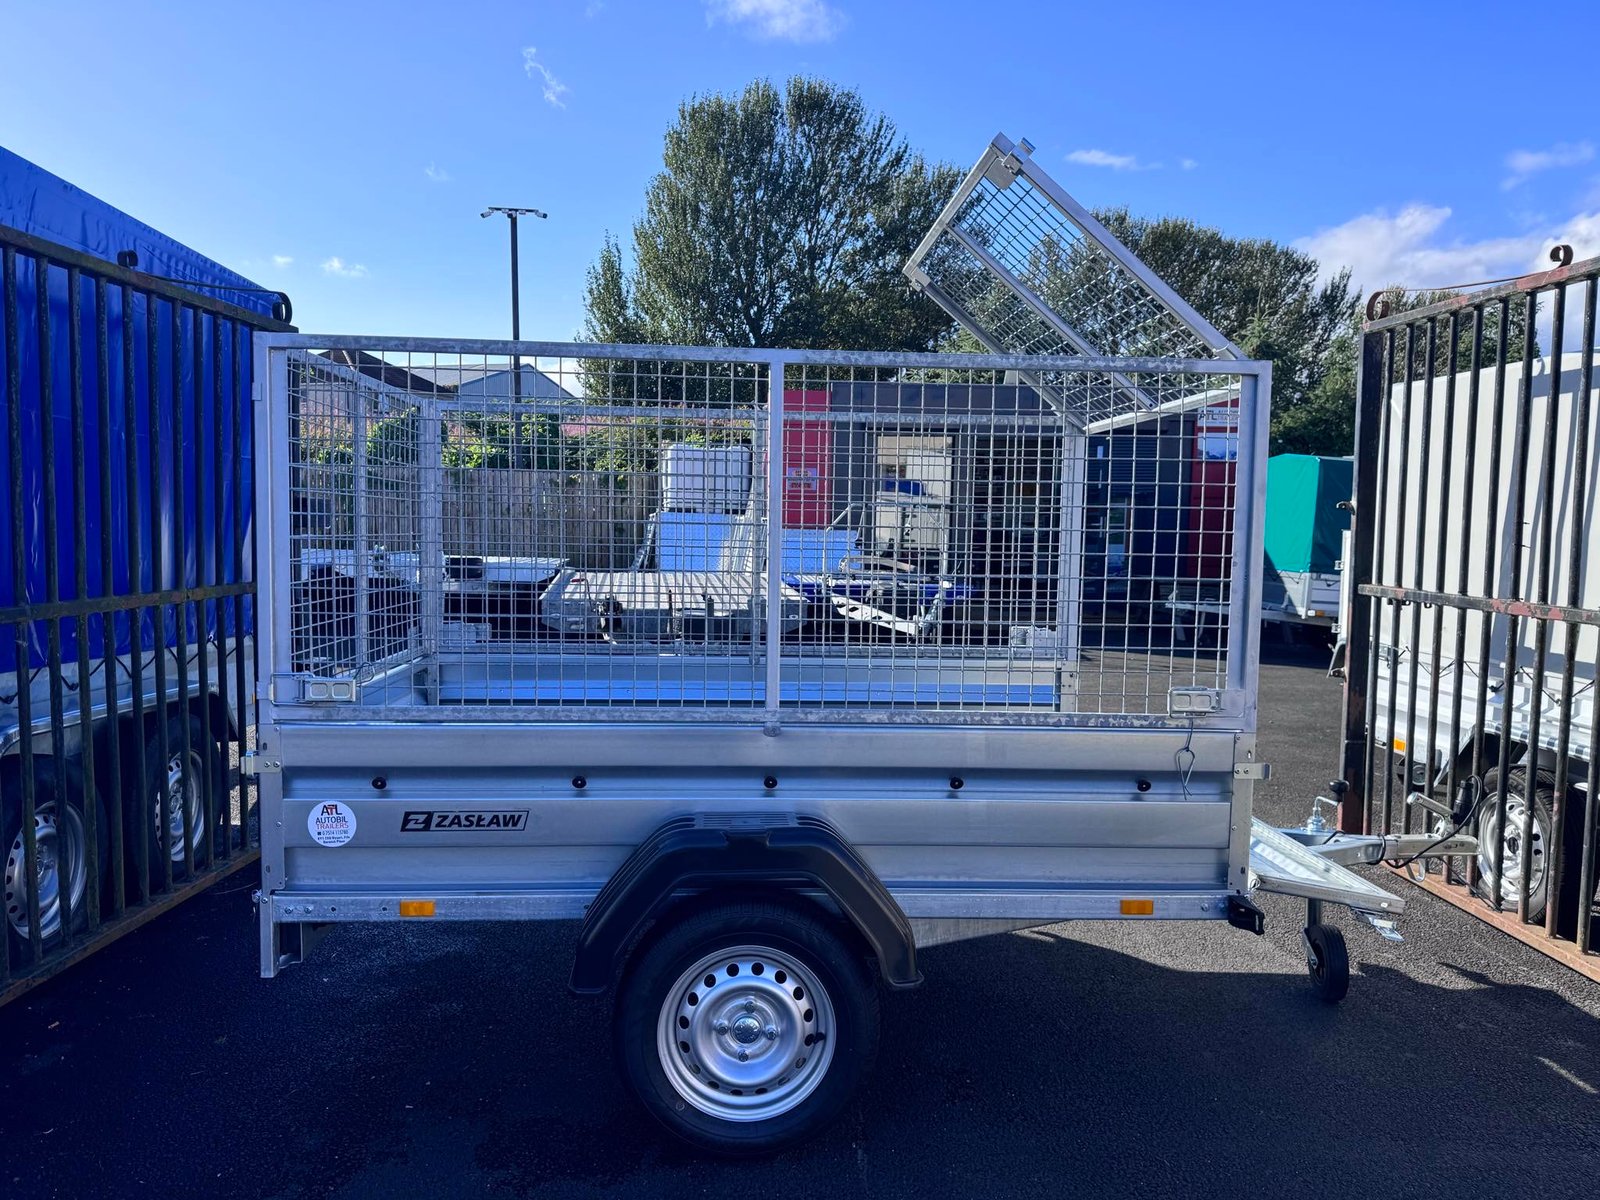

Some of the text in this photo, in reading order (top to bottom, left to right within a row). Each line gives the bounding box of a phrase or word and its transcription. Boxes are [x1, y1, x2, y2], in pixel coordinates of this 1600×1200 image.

[321, 804, 342, 816] ATL
[315, 816, 348, 824] AUTOBIL
[434, 814, 523, 828] ZASŁAW
